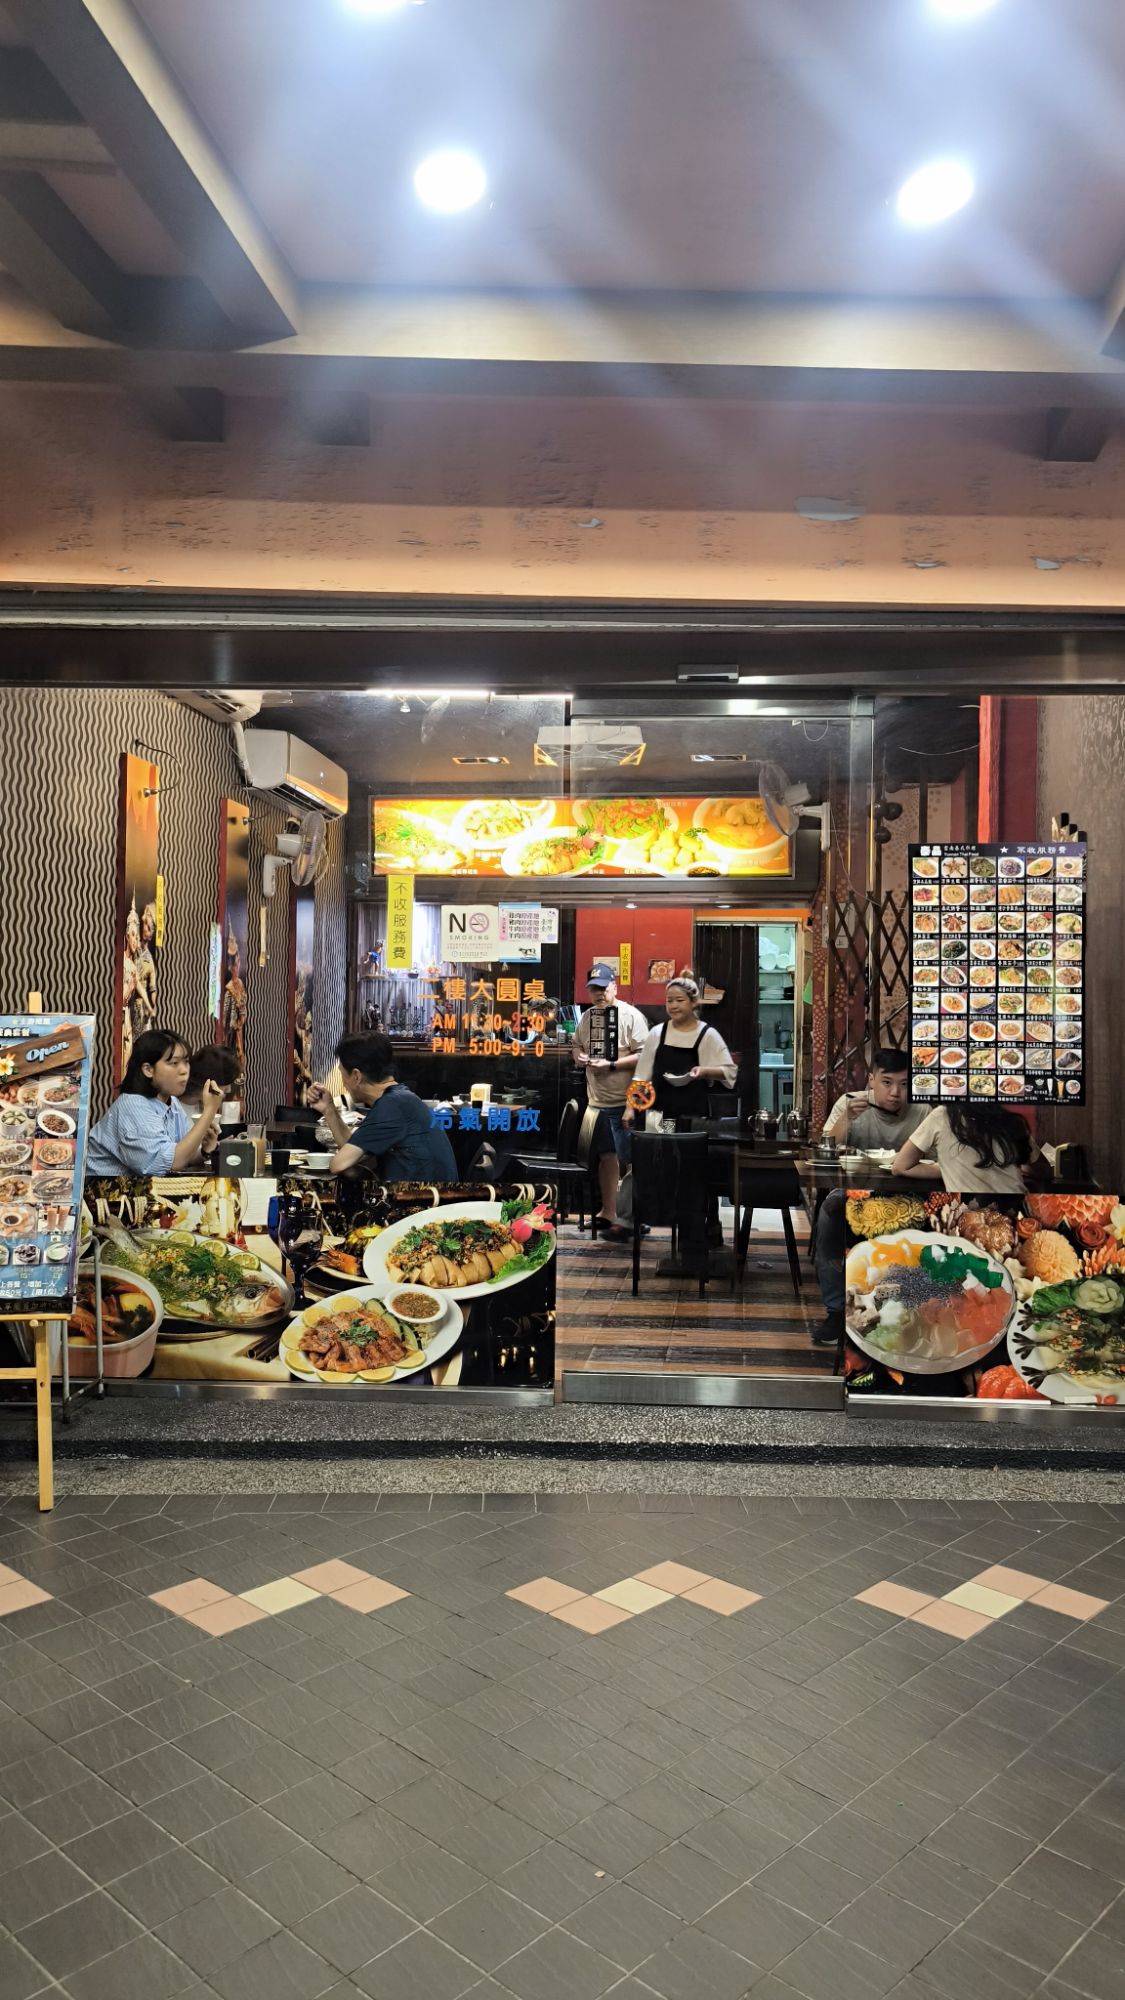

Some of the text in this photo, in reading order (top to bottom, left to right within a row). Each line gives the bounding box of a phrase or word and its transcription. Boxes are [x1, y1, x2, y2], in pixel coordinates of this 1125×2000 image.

[393, 881, 407, 960] 不收服務費
[416, 977, 546, 1002] 二樓大圓桌
[432, 1014, 457, 1030] AM
[25, 1041, 69, 1062] Open
[432, 1037, 457, 1054] PM
[429, 1107, 541, 1132] 冷氣開放
